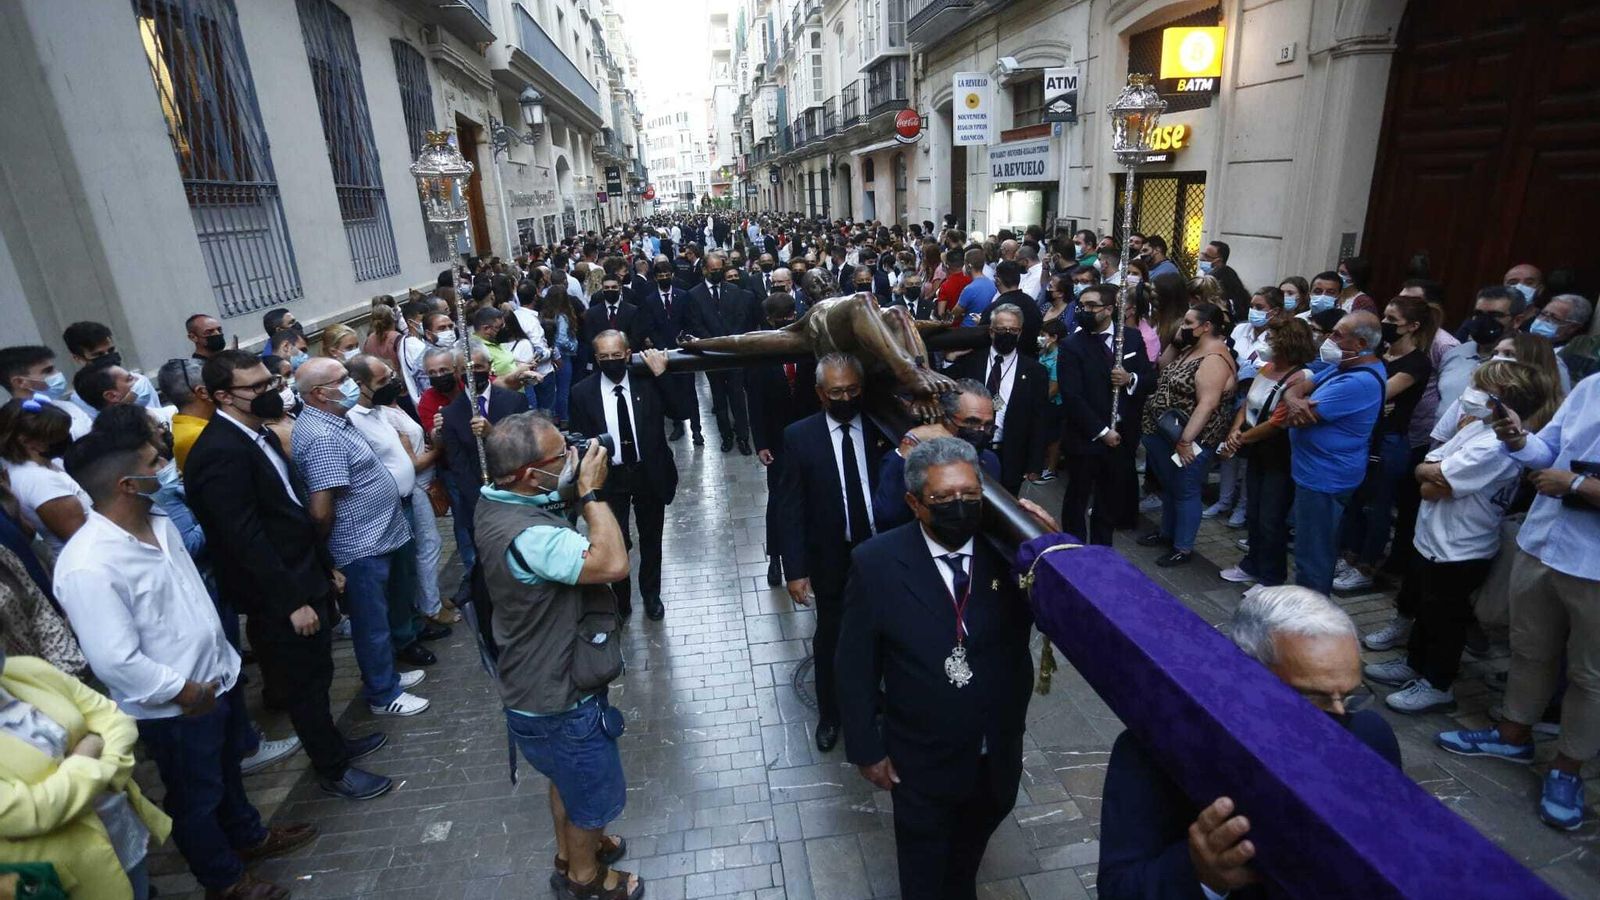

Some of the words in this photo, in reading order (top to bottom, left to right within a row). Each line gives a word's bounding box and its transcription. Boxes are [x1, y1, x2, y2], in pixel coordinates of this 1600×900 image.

[1280, 47, 1289, 60] 13
[958, 79, 964, 88] LA
[965, 78, 988, 88] REVUELO
[1046, 76, 1077, 90] ATM
[1177, 78, 1213, 91] BATM
[896, 117, 919, 128] Coca-Cola
[1150, 124, 1185, 151] ase
[993, 163, 1003, 177] LA
[1004, 159, 1045, 177] REVUELO
